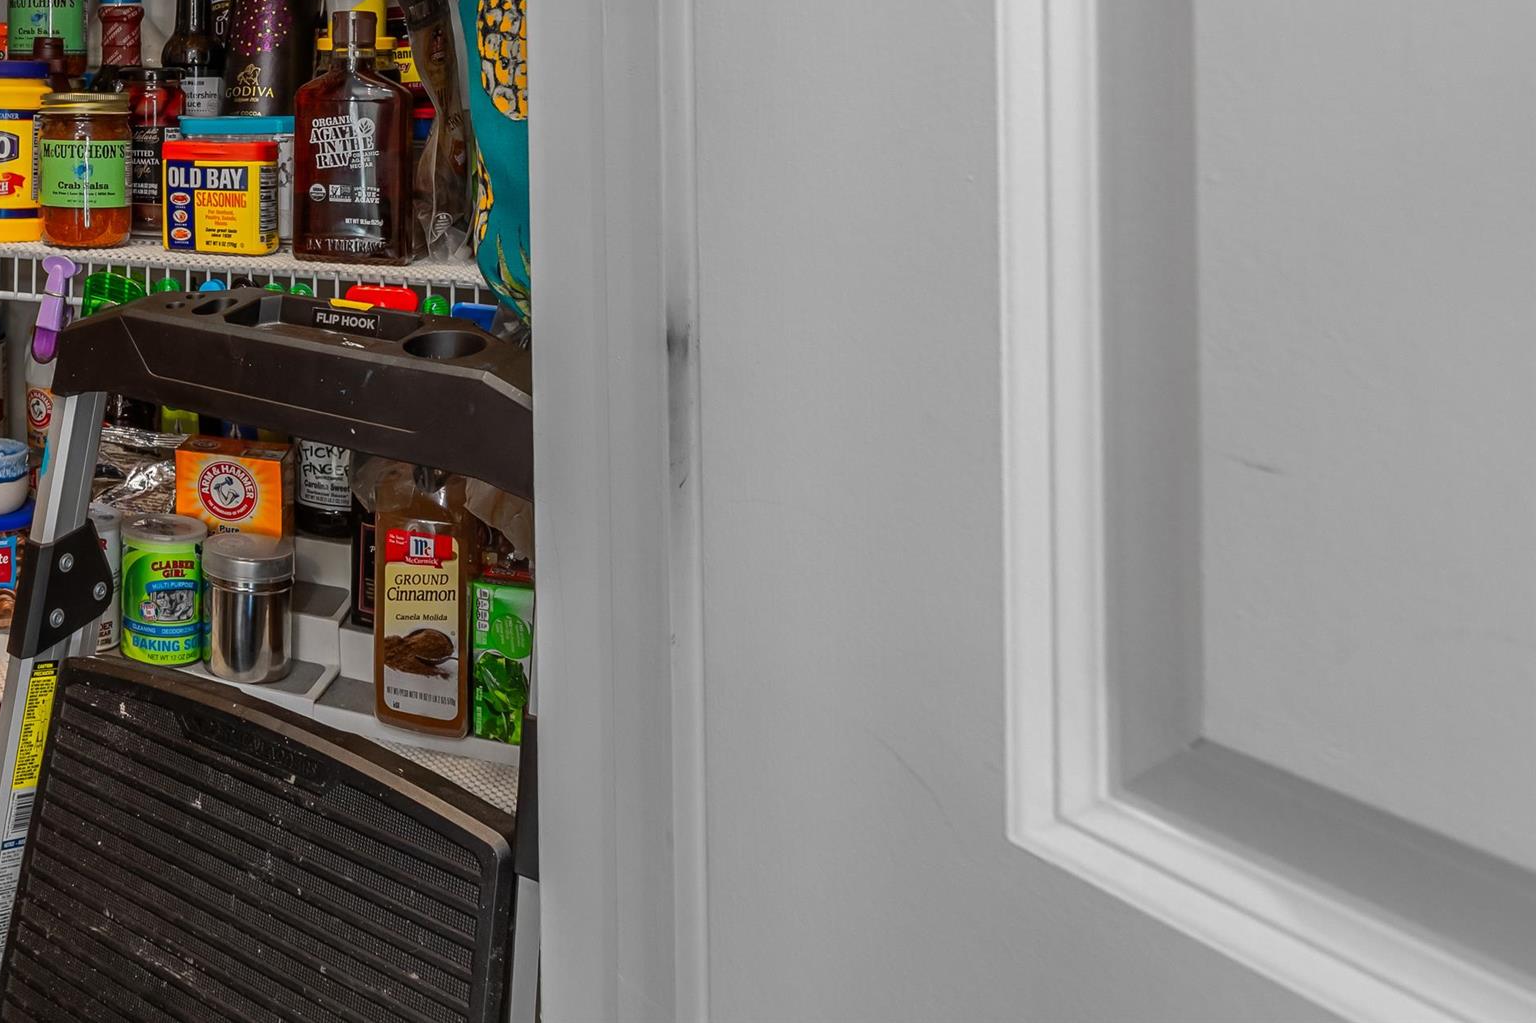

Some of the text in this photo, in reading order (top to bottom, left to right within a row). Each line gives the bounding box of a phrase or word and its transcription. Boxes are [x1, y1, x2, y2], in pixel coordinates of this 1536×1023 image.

[18, 27, 36, 35] Crab
[225, 86, 275, 99] GODIVA
[318, 136, 375, 154] IN THE
[316, 152, 351, 169] RAW
[168, 166, 244, 190] OLD BAY
[57, 181, 81, 190] Crab
[195, 191, 247, 208] SEASONING
[316, 311, 376, 330] FLIP HOOK
[201, 464, 255, 500] ARM HAMMER
[304, 479, 351, 493] Carolina Sweet
[150, 559, 195, 572] CLABBER
[404, 555, 439, 566] McCormick
[161, 569, 187, 579] GIRL
[394, 573, 449, 586] GROUND
[151, 581, 195, 590] MULTI PURPOSE
[386, 586, 457, 603] Cinnamon
[395, 613, 448, 622] Canela Molida
[131, 622, 157, 635] CLEANING
[132, 634, 180, 653] BAKING
